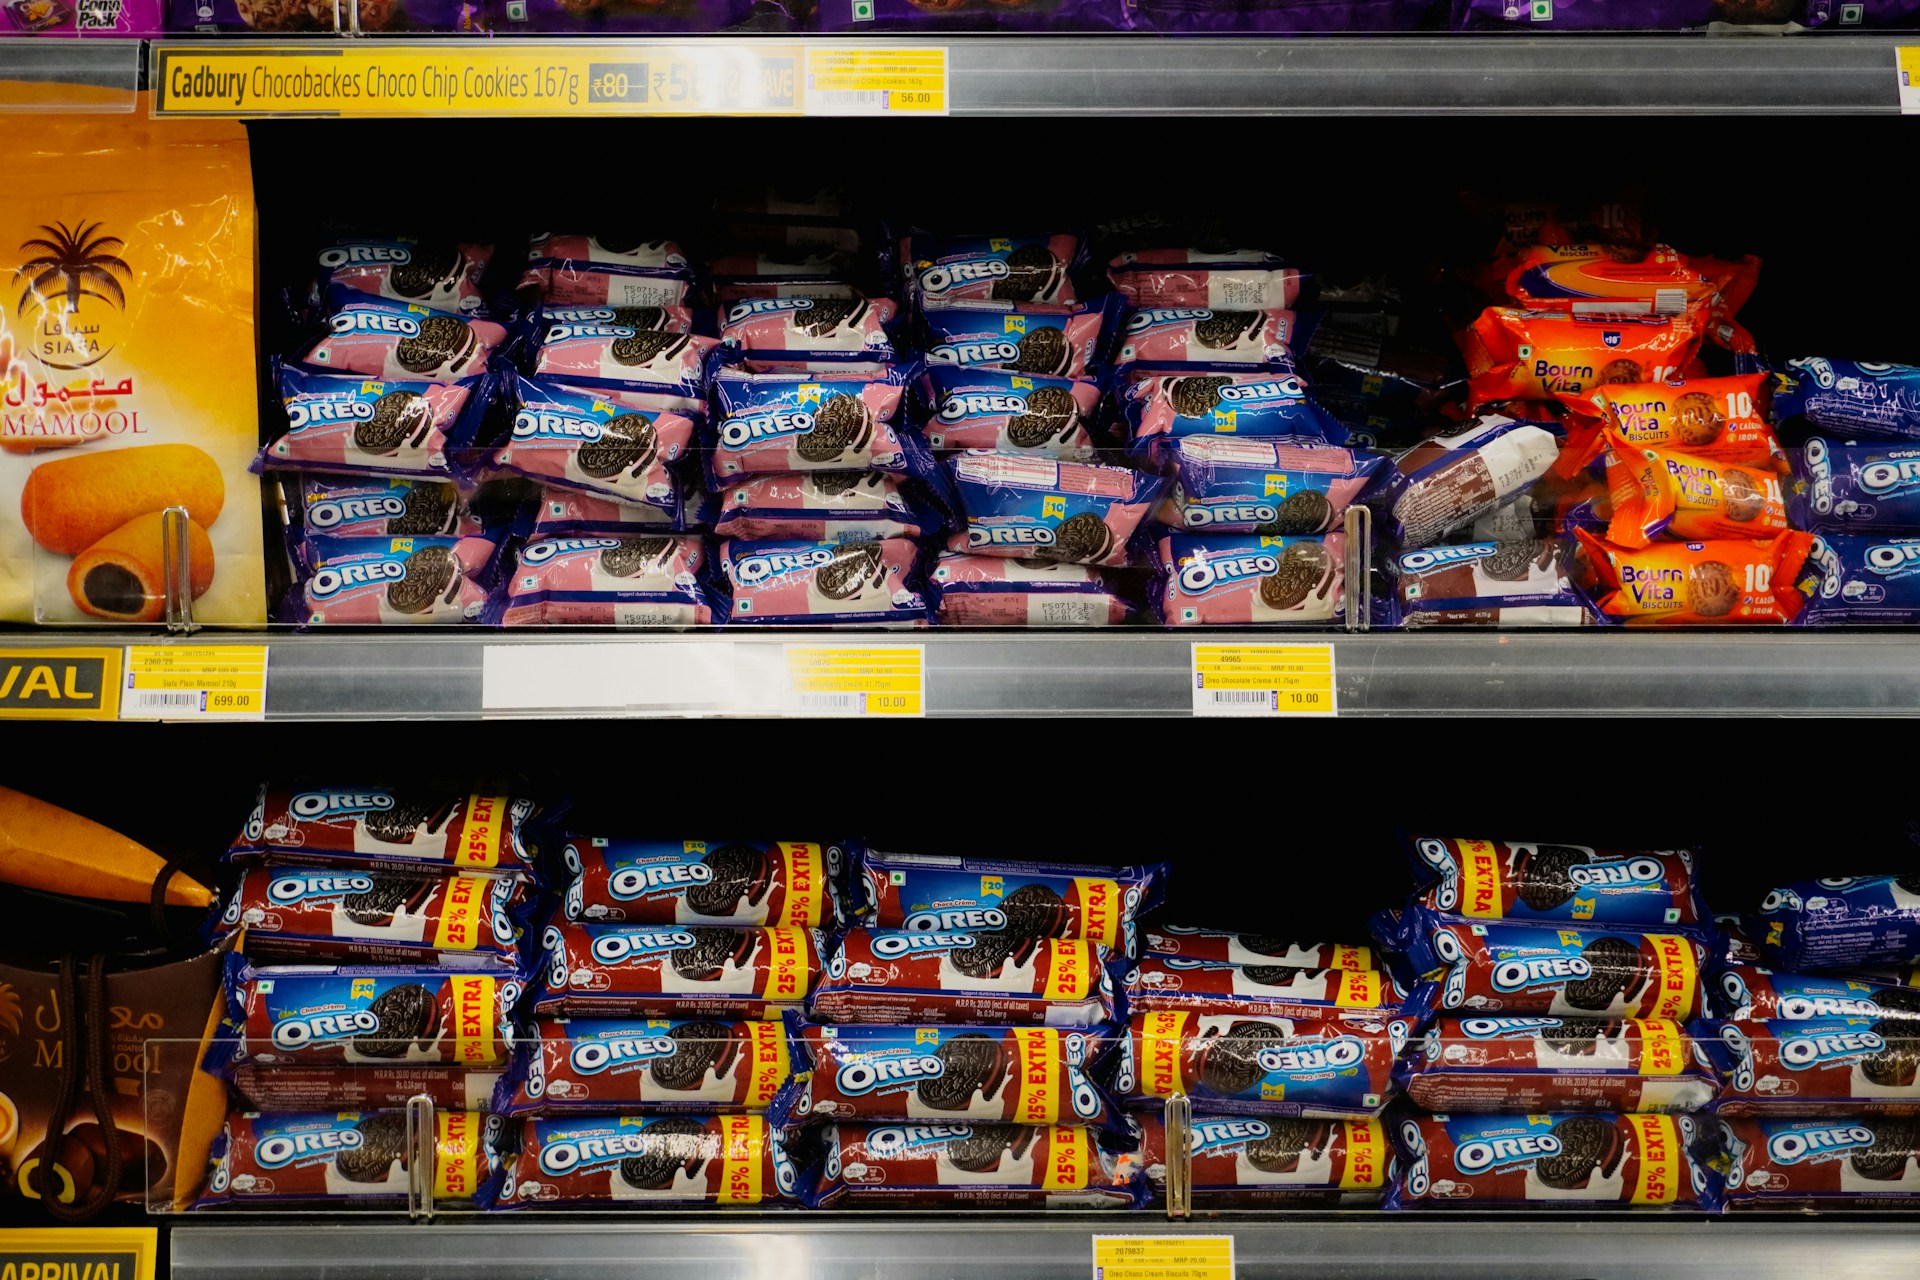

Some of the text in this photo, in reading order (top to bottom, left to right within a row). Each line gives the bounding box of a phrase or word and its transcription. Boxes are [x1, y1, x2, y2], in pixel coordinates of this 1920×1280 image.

[172, 66, 247, 105] Cadbury
[252, 65, 361, 98] Chocobackes
[366, 65, 417, 98] Choco
[421, 65, 458, 105] Chip
[463, 65, 528, 98] Cookies
[533, 66, 580, 105] 167g
[882, 77, 906, 85] Cookies
[901, 92, 931, 103] 56.00
[319, 247, 409, 268] OREO
[922, 262, 1008, 291] OREO
[729, 300, 813, 322] OREO
[1127, 309, 1211, 330] OREO
[330, 313, 418, 334] OREO
[544, 325, 633, 344] OREO
[1535, 360, 1593, 378] Bourn
[1221, 376, 1304, 401] OREO
[1541, 375, 1582, 394] Vita
[286, 403, 372, 428] OREO
[942, 397, 1026, 419] OREO
[2, 411, 148, 437] MAMOOL
[514, 414, 600, 439] OREO
[723, 413, 812, 446] OREO
[1618, 415, 1659, 436] Vita
[1629, 431, 1669, 441] BISCUITS
[1738, 433, 1758, 441] IRON
[1666, 460, 1718, 480] Bourn
[1678, 475, 1712, 497] Vita
[310, 498, 403, 527] OREO
[1045, 501, 1064, 513] ₹10
[1686, 494, 1719, 507] BISCUITS
[1185, 507, 1275, 528] OREO
[968, 527, 1053, 547] OREO
[525, 539, 618, 561] OREO
[1402, 546, 1494, 568] OREO
[737, 551, 832, 580] OREO
[1182, 556, 1277, 590] OREO
[1622, 565, 1683, 583] Bourn
[312, 562, 403, 594] OREO
[1632, 581, 1674, 604] Vita
[1642, 600, 1684, 610] BISCUITS
[1752, 606, 1772, 615] IRON
[179, 679, 195, 688] Plain
[196, 679, 221, 688] Mamool
[214, 695, 250, 706] 699.00
[877, 696, 906, 707] 10.00
[1290, 693, 1319, 703] 10.00
[293, 792, 394, 816] OREO
[468, 824, 488, 861] 25%
[635, 856, 658, 864] Choco
[793, 843, 809, 892] EXTRA
[1571, 859, 1662, 885] OREO
[270, 875, 371, 901] OREO
[612, 865, 709, 895] OREO
[1473, 854, 1492, 914] EXTRA
[932, 900, 953, 909] Choco
[1086, 882, 1106, 941] EXTRA
[906, 908, 1005, 932] OREO
[594, 932, 693, 960] OREO
[873, 934, 974, 959] OREO
[1058, 957, 1077, 994] 25%
[1494, 957, 1590, 988] OREO
[1666, 937, 1684, 990] EXTRA
[778, 958, 796, 994] 25%
[301, 1006, 321, 1015] Choco
[463, 980, 482, 1038] EXTRA
[977, 1000, 991, 1008] 20.00
[274, 1013, 377, 1048] OREO
[1463, 1018, 1560, 1037] OREO
[574, 1037, 674, 1071] OREO
[1260, 1039, 1362, 1071] OREO
[1784, 1033, 1882, 1064] OREO
[840, 1057, 943, 1095] OREO
[1028, 1029, 1046, 1121] 25% EXTRA
[1154, 1040, 1173, 1096] EXTRA
[259, 1129, 362, 1164] OREO
[870, 1125, 972, 1151] OREO
[1772, 1127, 1873, 1159] OREO
[544, 1137, 643, 1171] OREO
[1458, 1135, 1560, 1169] OREO
[1647, 1165, 1665, 1200] 25%
[1115, 1247, 1145, 1255] 2079837
[1191, 1270, 1208, 1279] 70gm
